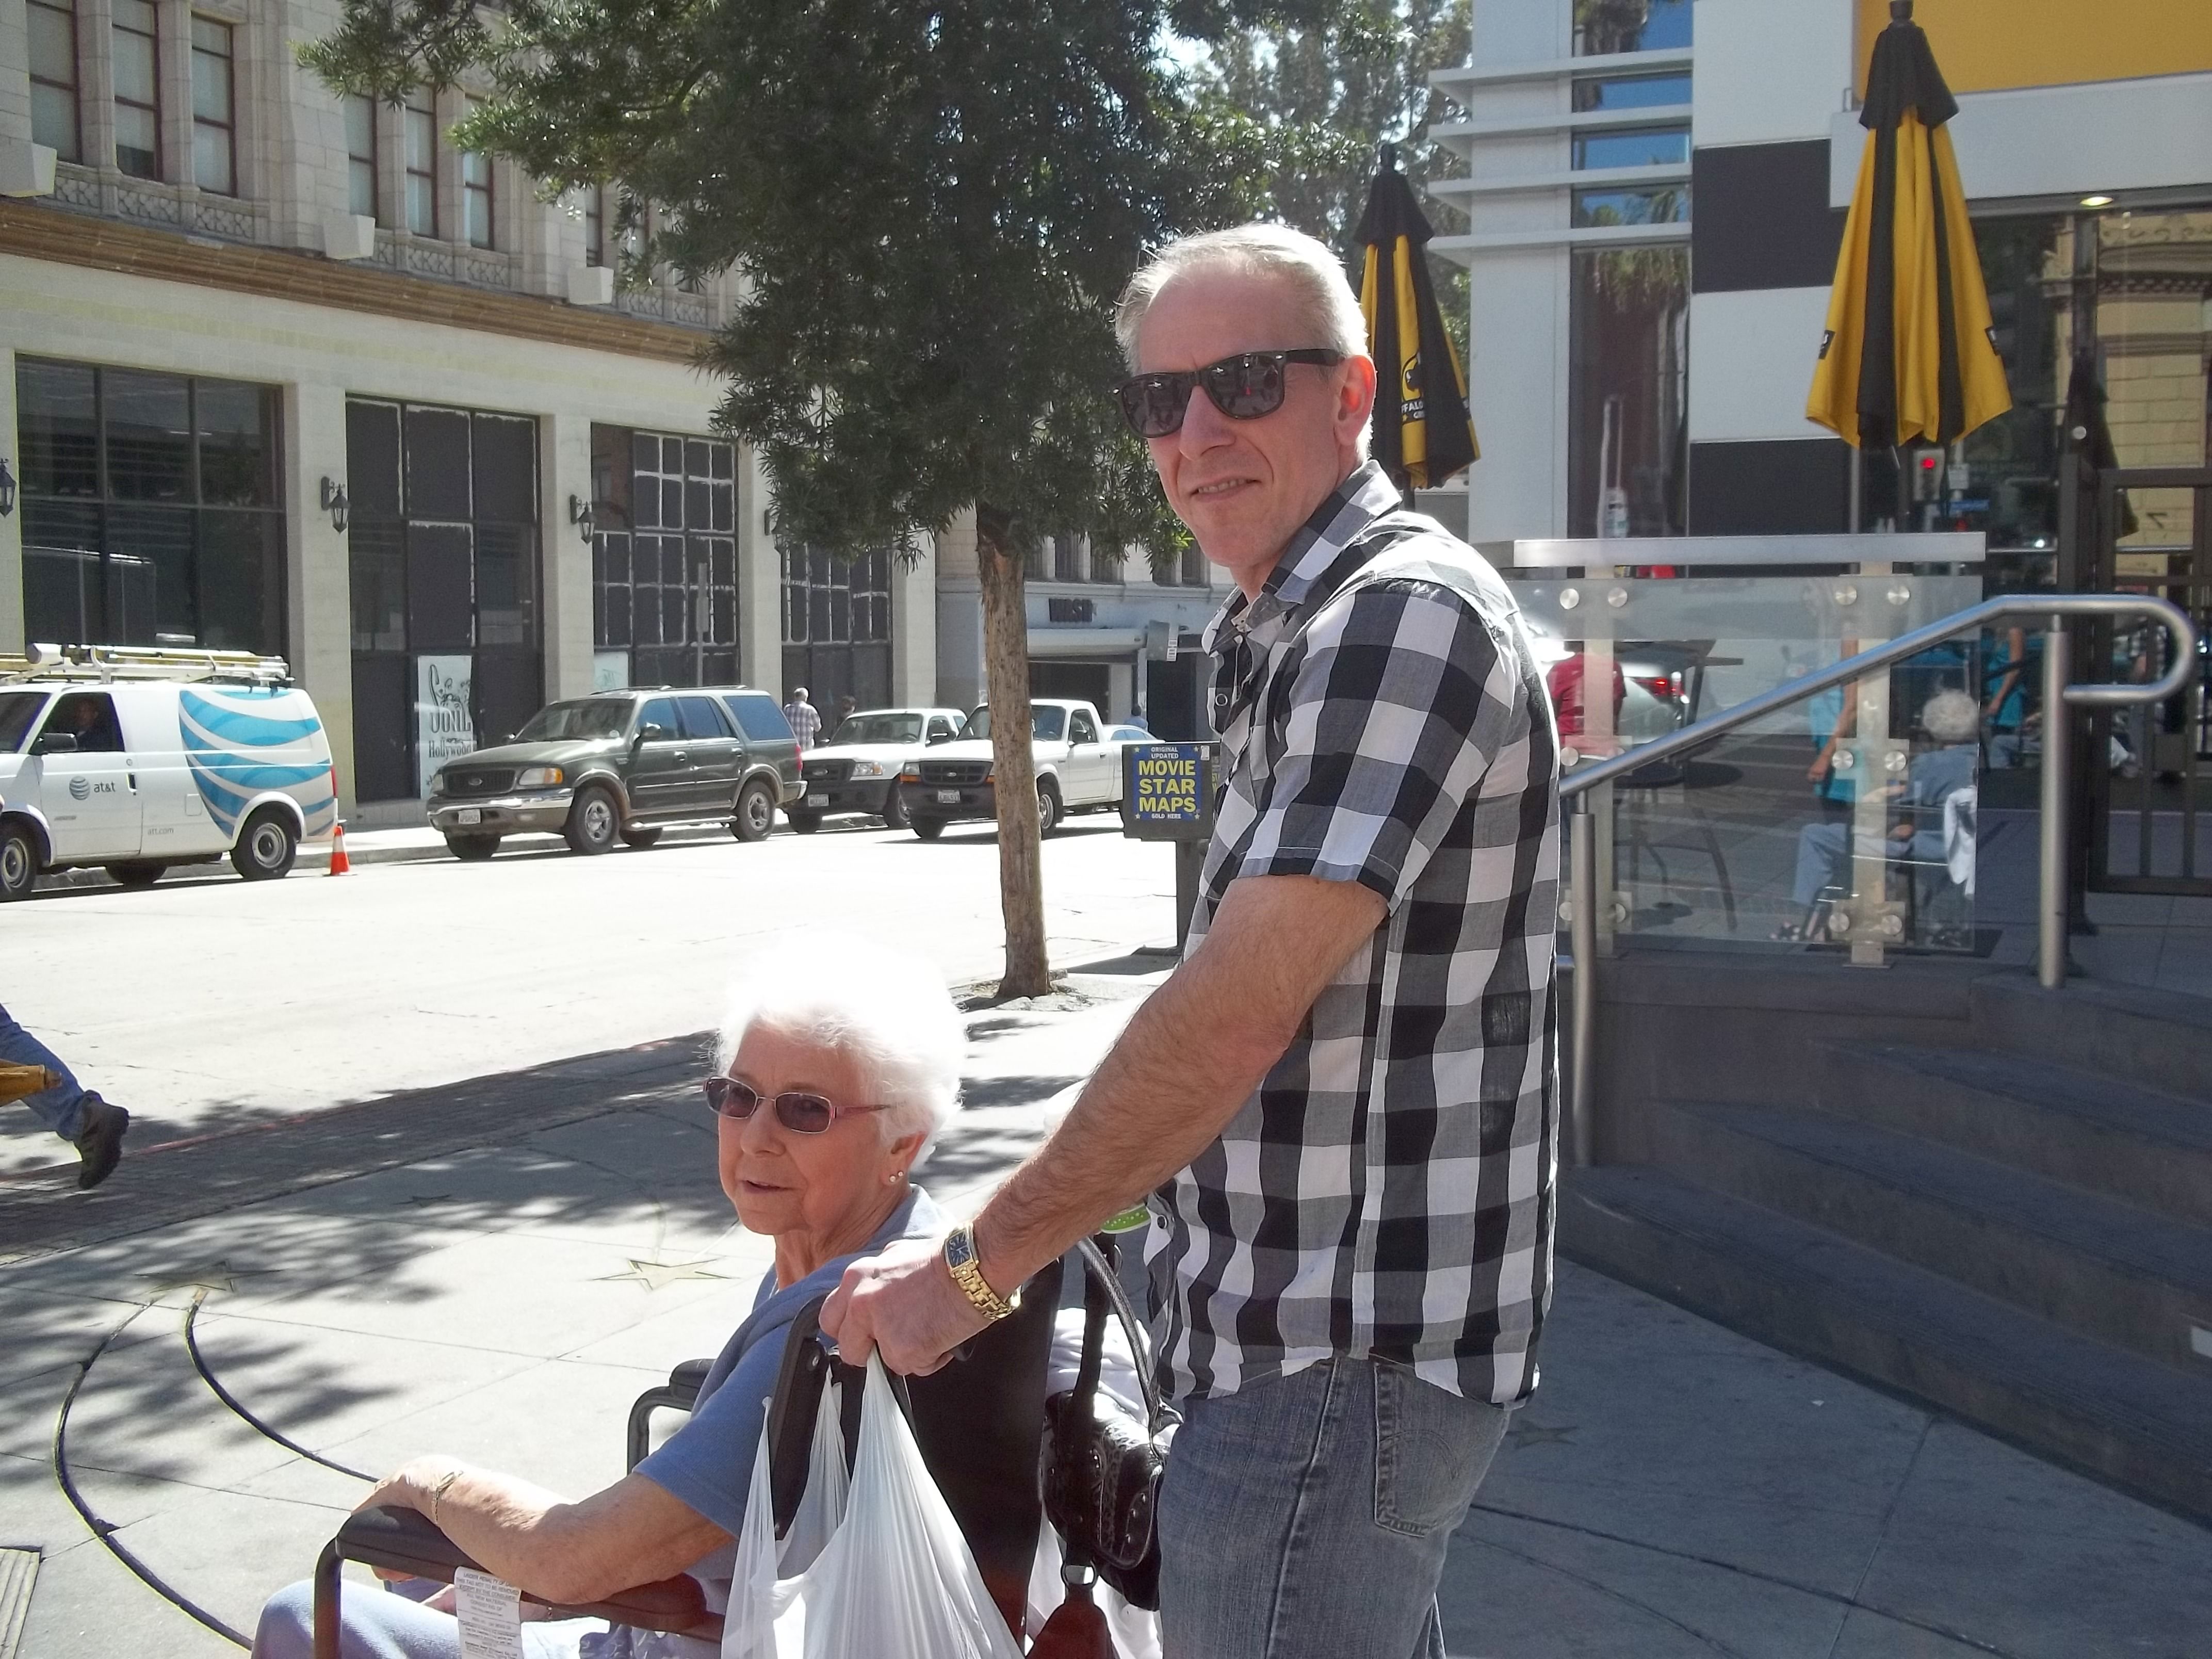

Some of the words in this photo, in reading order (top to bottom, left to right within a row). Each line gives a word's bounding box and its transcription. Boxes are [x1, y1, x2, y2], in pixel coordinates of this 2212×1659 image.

[1138, 760, 1196, 775] MOVIE
[93, 782, 116, 793] at&t
[1138, 778, 1195, 794] STAR
[1139, 797, 1196, 812] MAPS
